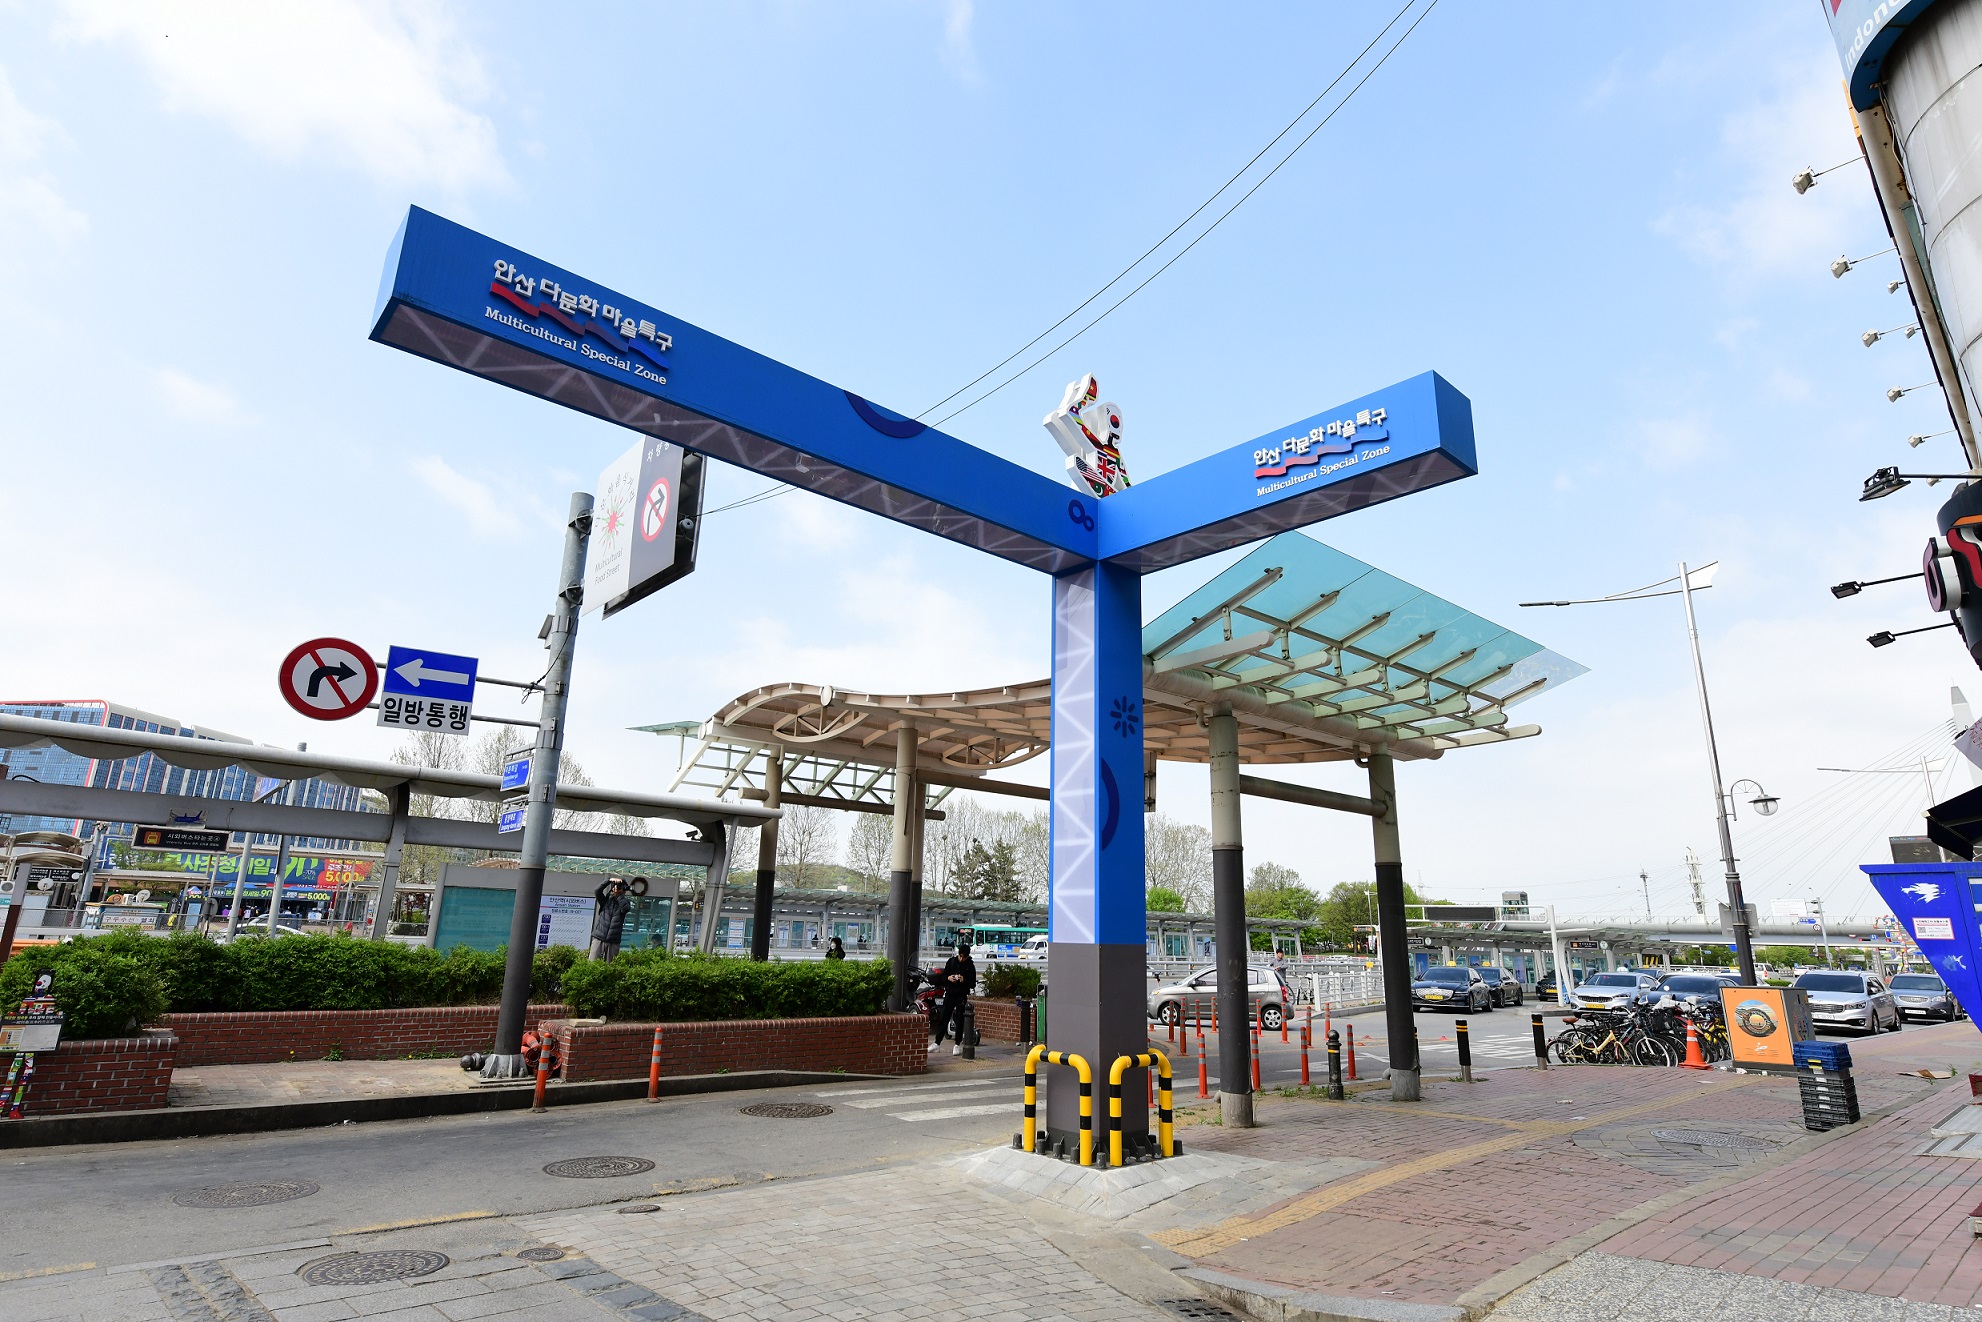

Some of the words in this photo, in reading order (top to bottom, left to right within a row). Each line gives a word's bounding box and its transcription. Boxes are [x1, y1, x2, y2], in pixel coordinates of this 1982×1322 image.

[493, 258, 537, 299] 안산
[539, 276, 600, 319] 다문화
[602, 303, 674, 353] 마을특구
[484, 305, 578, 353] Multicultural
[579, 342, 631, 373] Special
[634, 362, 668, 386] Zone
[1253, 446, 1282, 467] 안산
[1282, 426, 1326, 455] 다문화
[1326, 407, 1389, 439] 마을특구
[1256, 468, 1318, 497] Multicultural
[1319, 454, 1360, 476] Special
[1361, 444, 1391, 461] Zone
[384, 697, 468, 730] 일방통행
